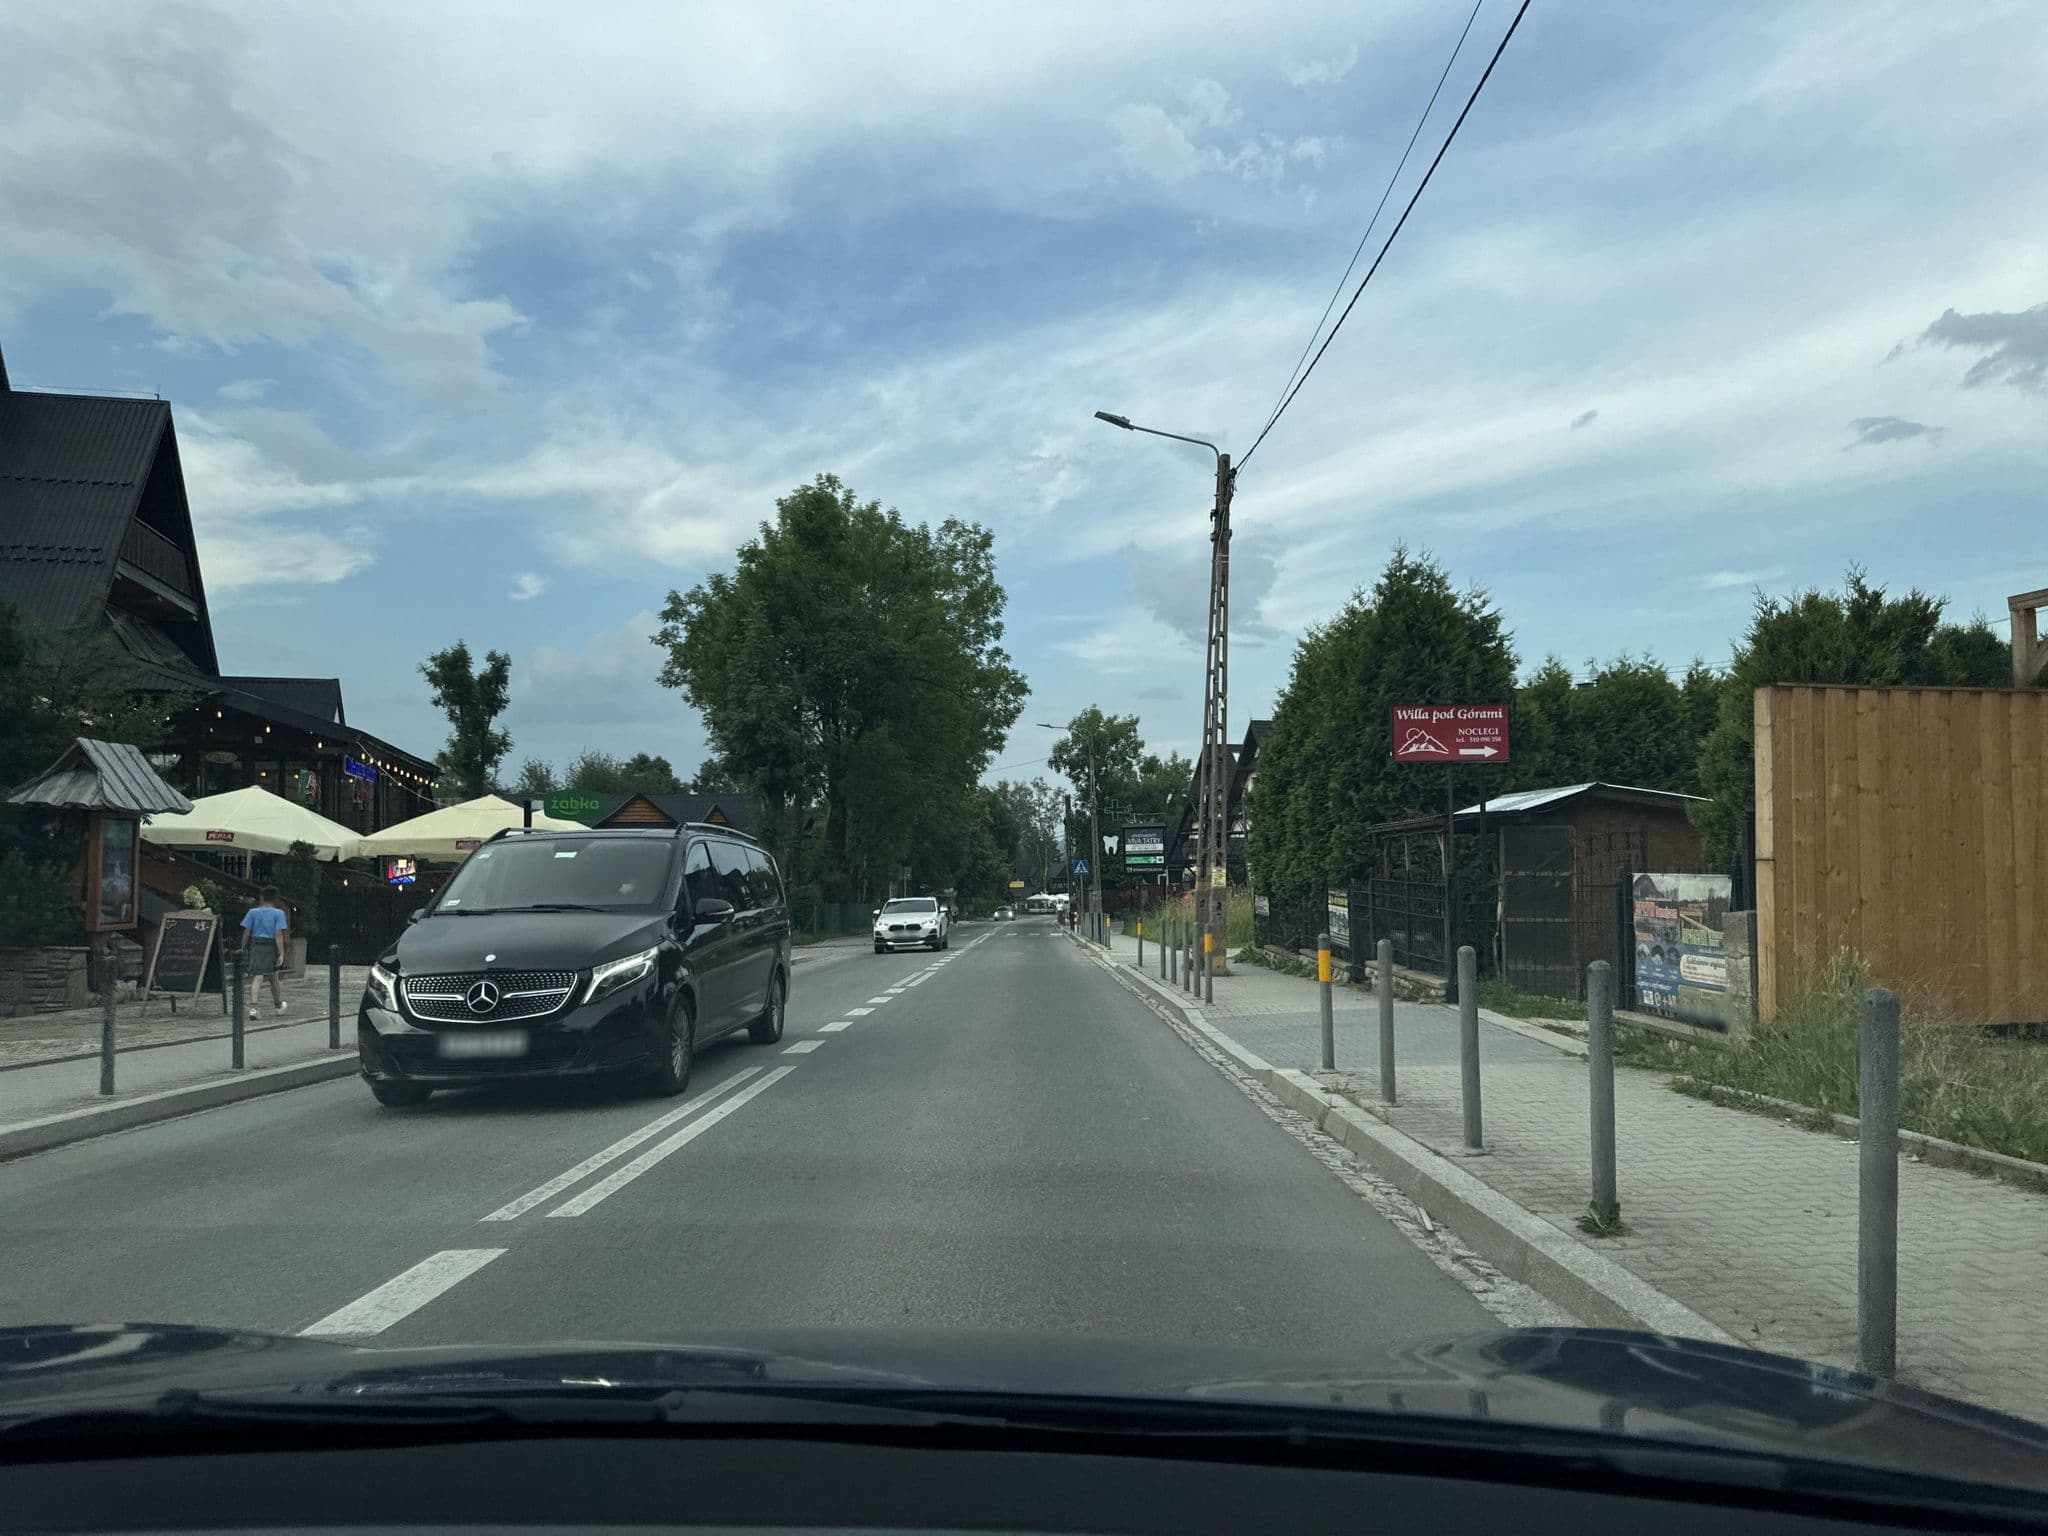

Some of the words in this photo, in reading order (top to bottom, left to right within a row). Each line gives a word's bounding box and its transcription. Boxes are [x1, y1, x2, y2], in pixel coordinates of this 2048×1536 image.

[1397, 708, 1429, 720] Willa
[1432, 708, 1455, 723] pod
[1457, 708, 1503, 720] Górami
[1458, 727, 1498, 735] NOCLEGI
[551, 796, 600, 810] żabka
